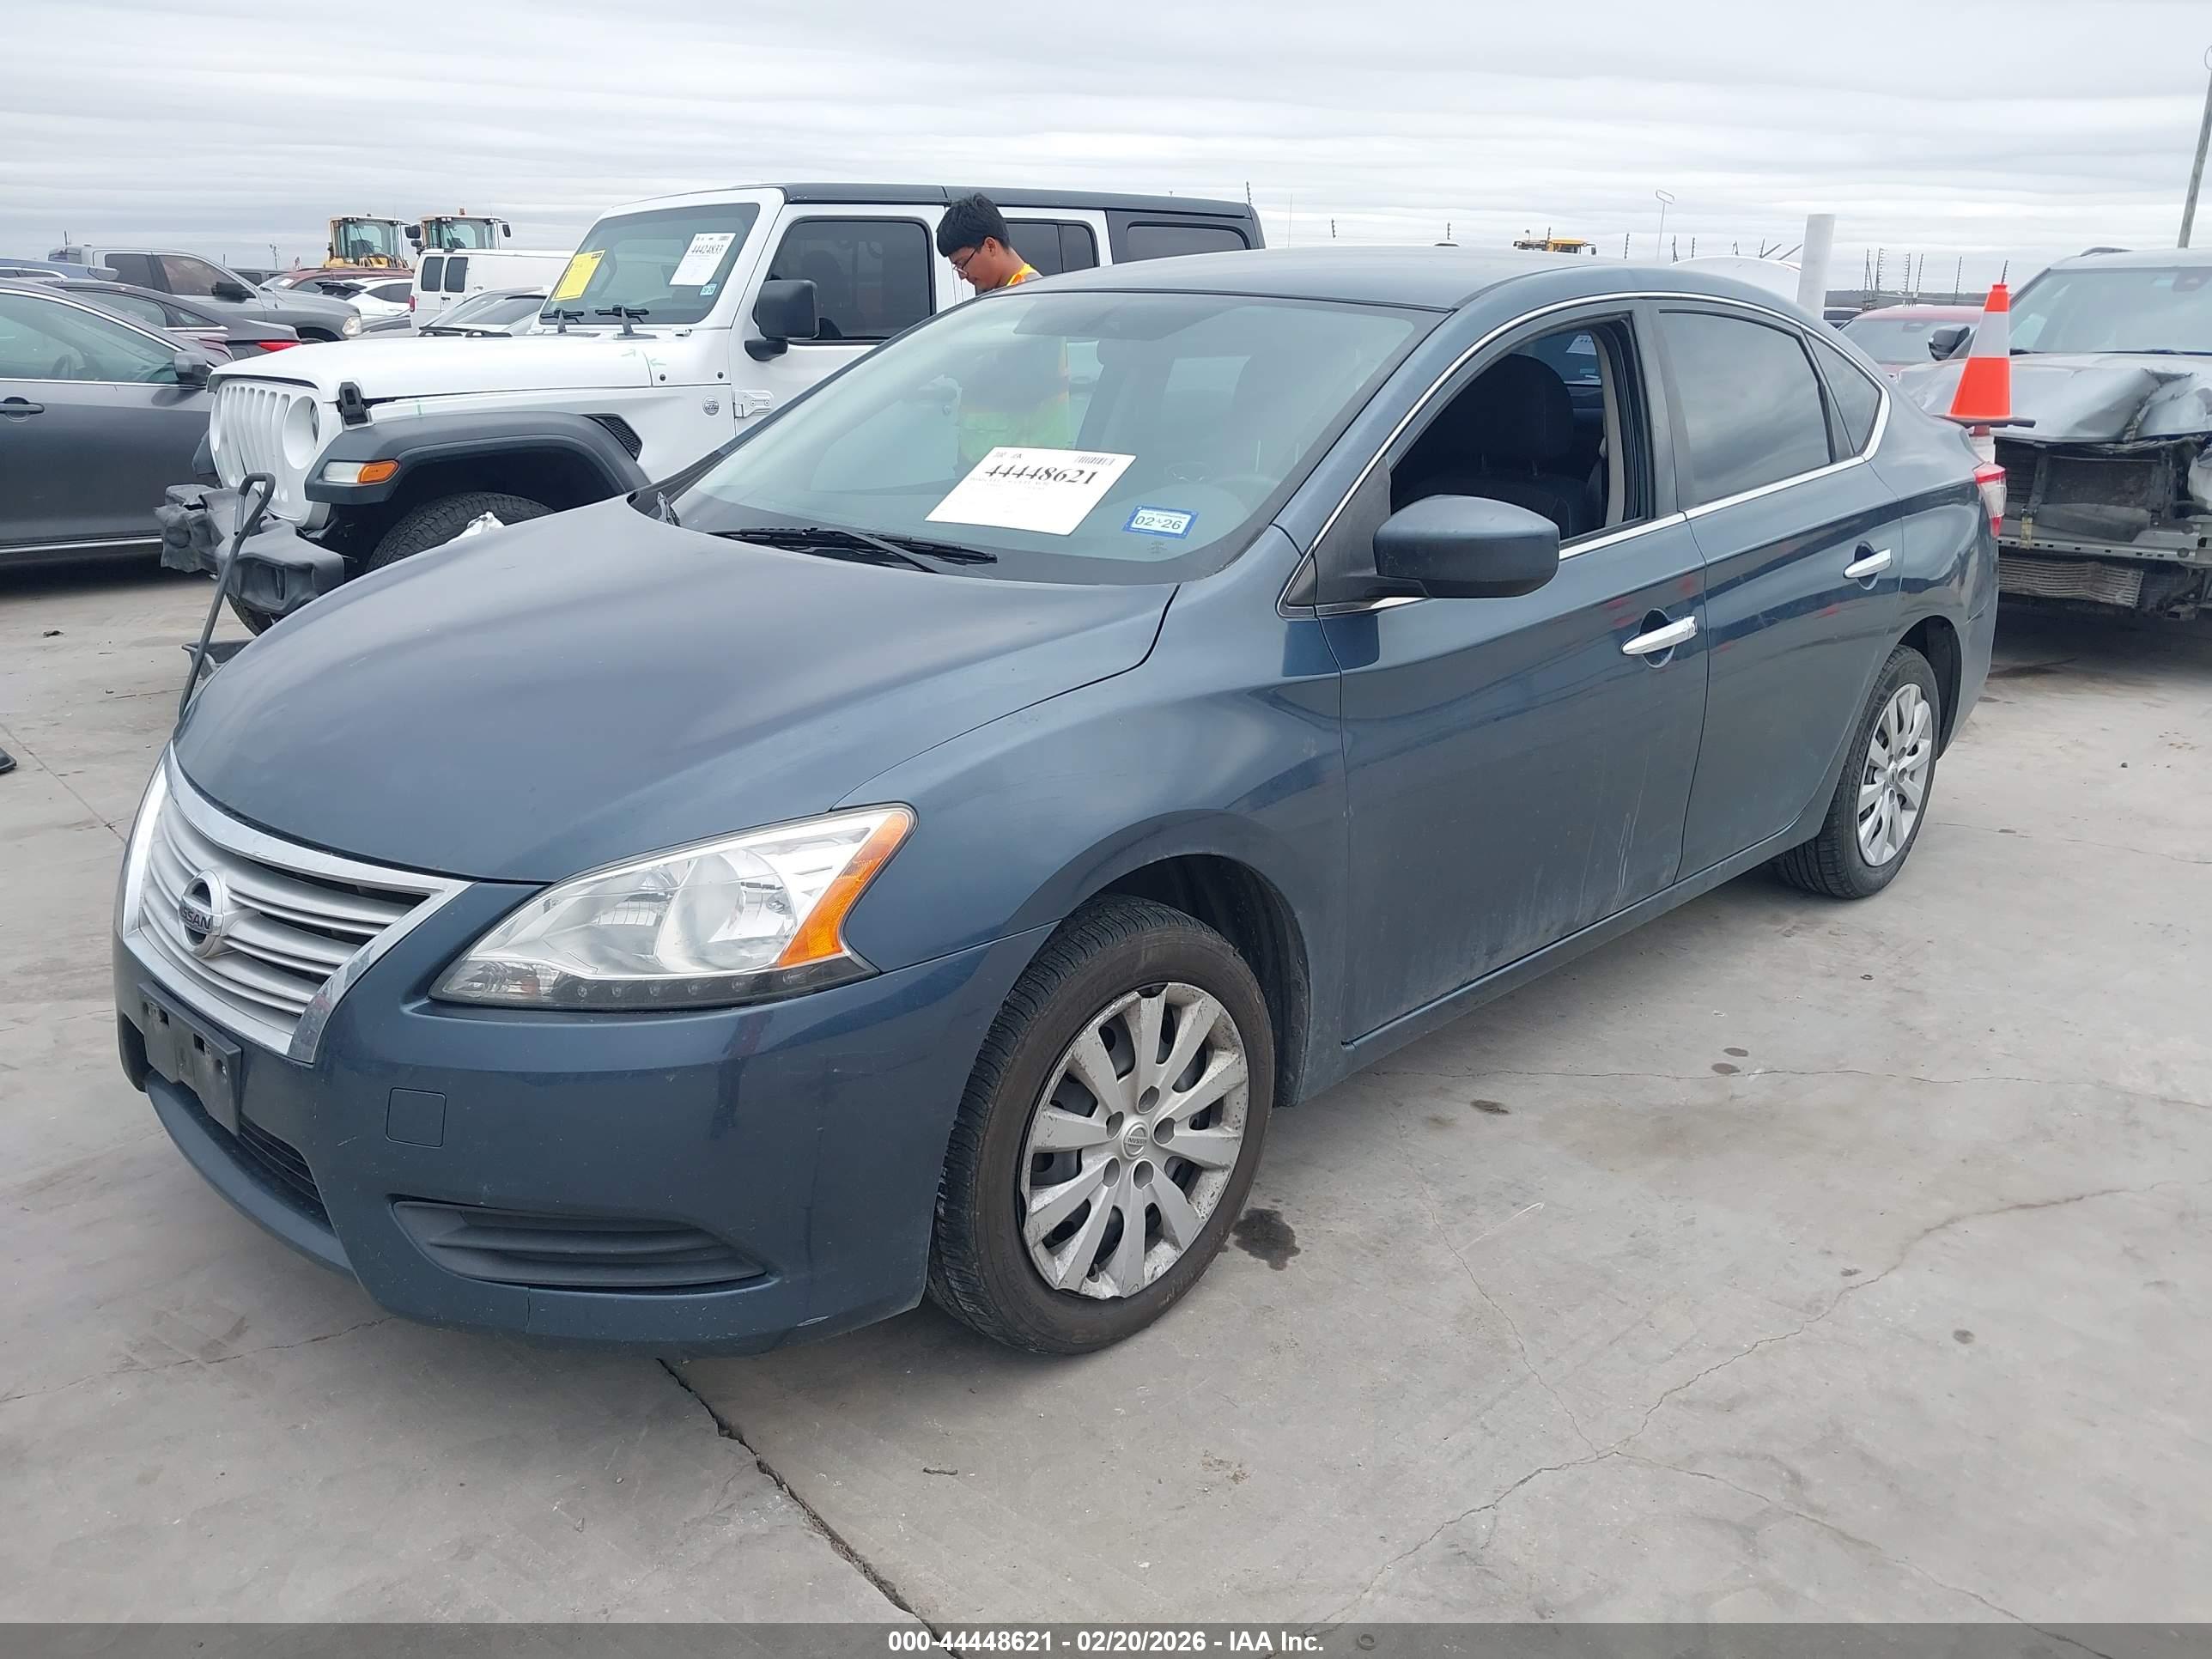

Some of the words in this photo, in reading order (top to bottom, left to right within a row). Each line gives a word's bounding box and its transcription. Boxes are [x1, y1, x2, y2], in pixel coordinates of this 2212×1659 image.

[985, 464, 1099, 485] 44448621
[1134, 515, 1155, 526] 02
[1160, 519, 1182, 530] 26
